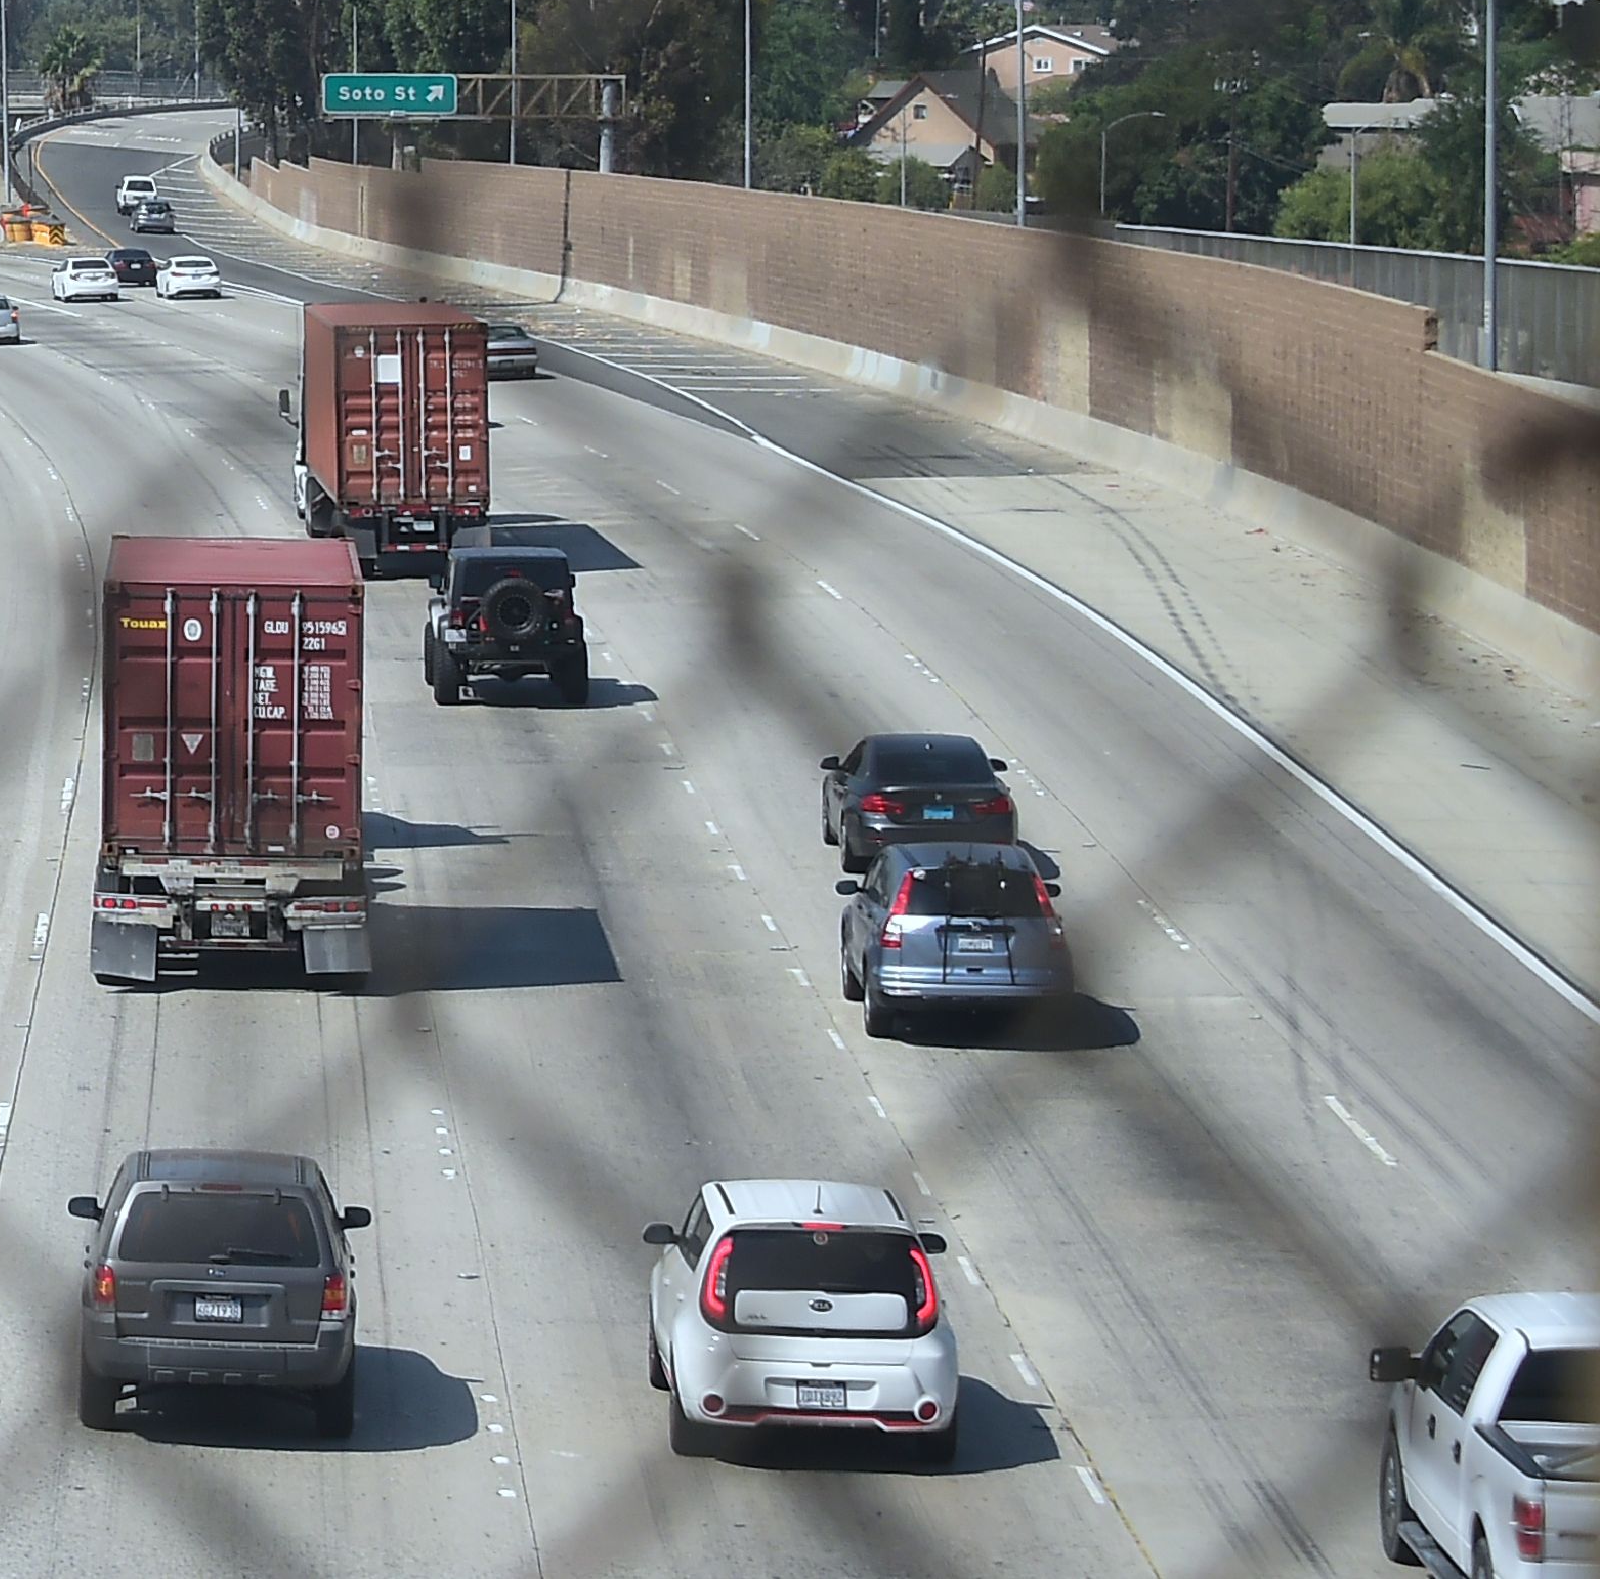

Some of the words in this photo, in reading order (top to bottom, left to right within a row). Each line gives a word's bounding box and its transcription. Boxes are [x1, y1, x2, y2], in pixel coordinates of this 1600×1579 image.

[338, 86, 385, 101] Soto
[394, 86, 416, 101] St
[120, 617, 167, 628] Touax
[264, 621, 289, 634] GLDU
[301, 620, 347, 635] 9515965
[302, 637, 326, 650] 22G1
